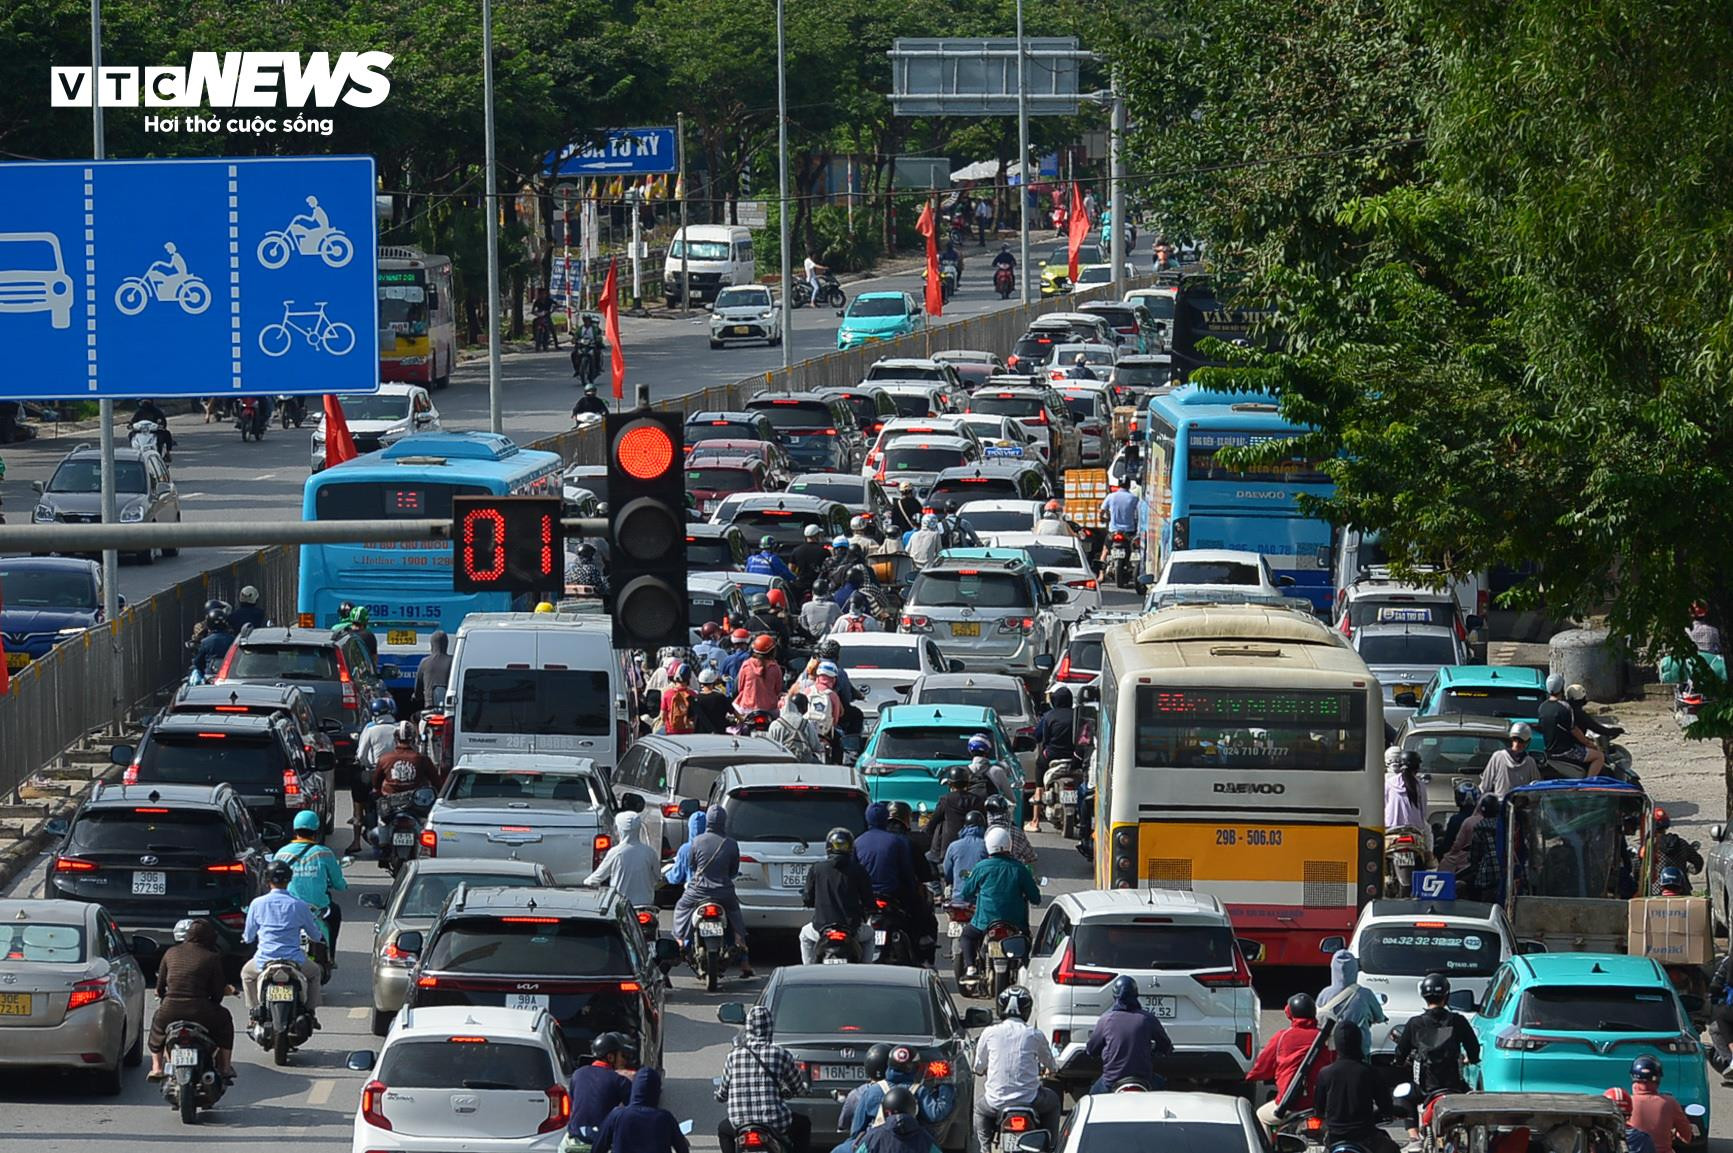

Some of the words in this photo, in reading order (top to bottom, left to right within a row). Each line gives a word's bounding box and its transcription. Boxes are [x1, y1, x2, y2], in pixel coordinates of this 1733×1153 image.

[1236, 490, 1285, 499] DAEWOO
[464, 509, 552, 581] 01
[400, 606, 442, 617] 191.55
[1241, 747, 1259, 756] 710
[1213, 782, 1285, 795] DAEWOO
[1216, 829, 1237, 846] 29B
[1246, 829, 1283, 846] 506.03
[140, 872, 159, 882] 30G
[1422, 874, 1446, 897] G7
[518, 994, 537, 1005] 98A
[1145, 996, 1164, 1007] 30K
[825, 1066, 866, 1079] 16N-16
